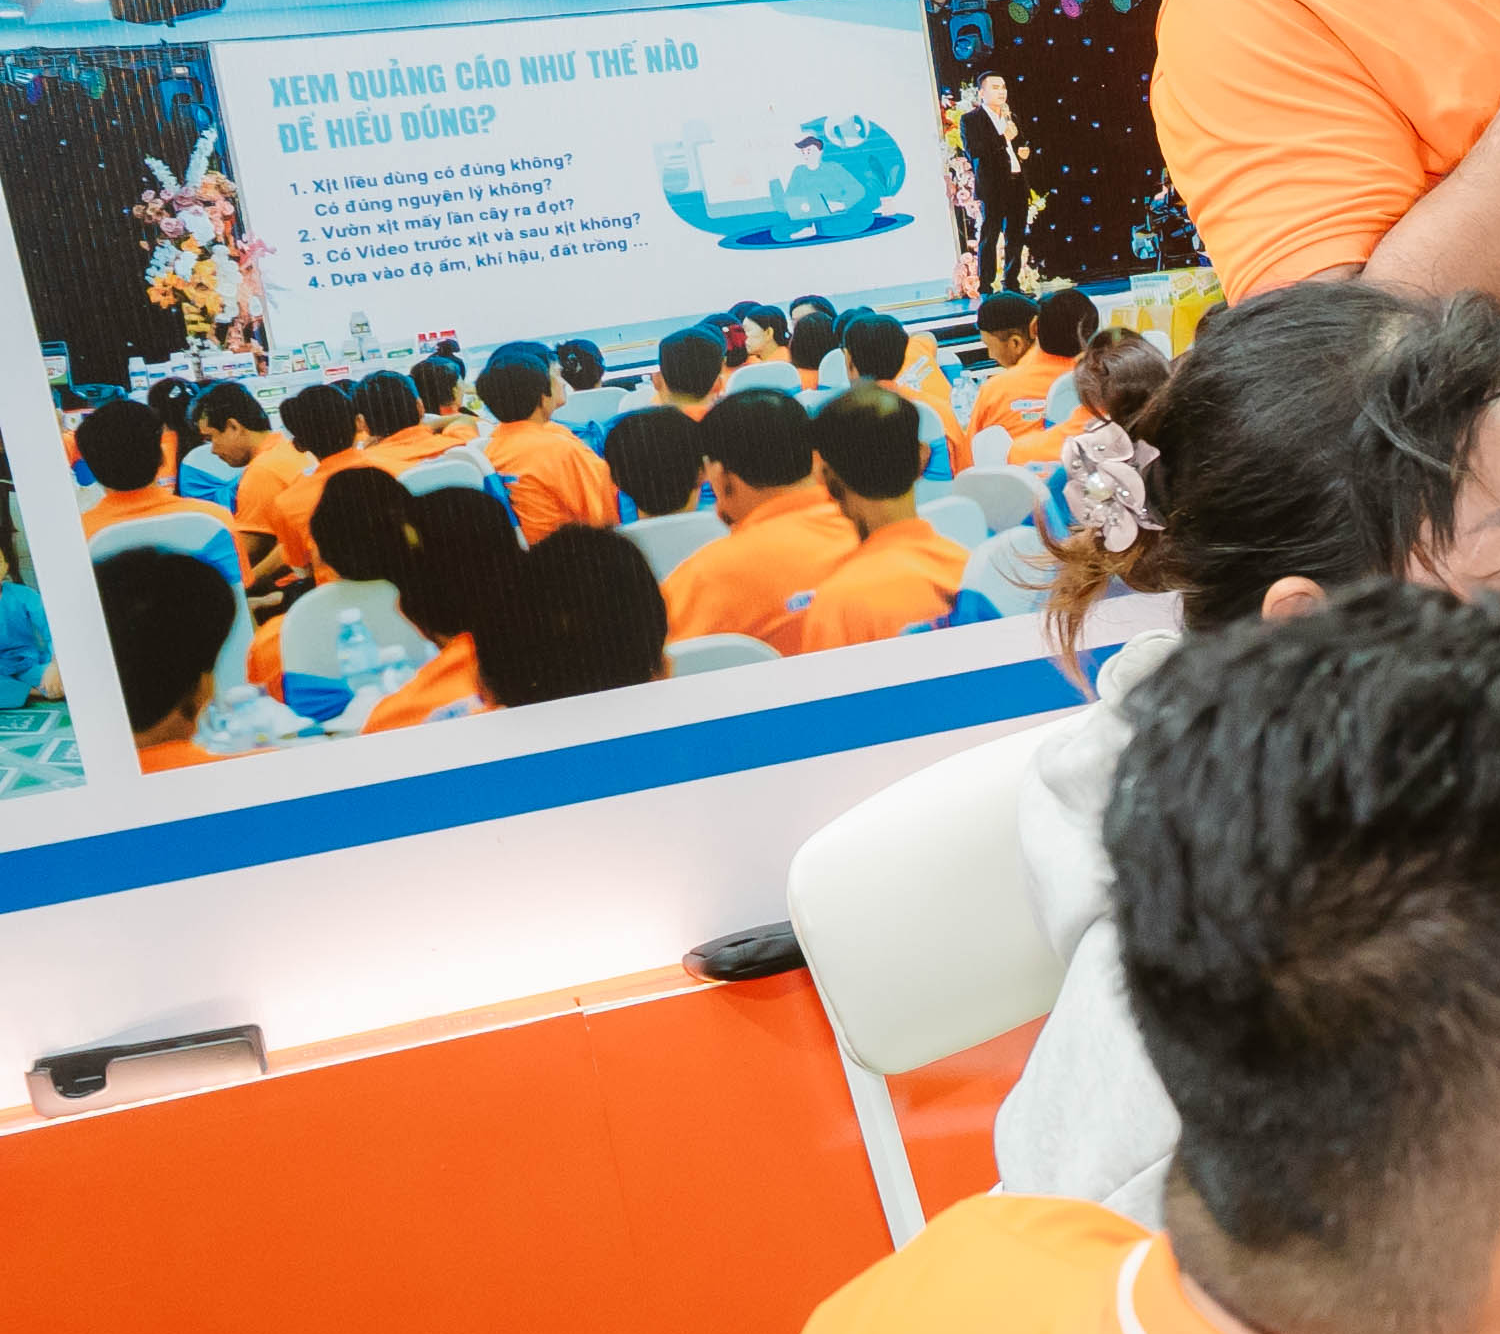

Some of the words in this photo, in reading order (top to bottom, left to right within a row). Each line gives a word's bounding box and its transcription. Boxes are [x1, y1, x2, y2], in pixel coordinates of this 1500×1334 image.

[269, 73, 338, 107] XEM
[347, 59, 446, 103] QUẢNG
[456, 54, 511, 91] CÁO
[520, 50, 576, 85] NHƯ
[586, 40, 638, 79] THẾ
[644, 38, 700, 73] NÀO
[327, 106, 392, 147] HIỂU
[401, 104, 496, 141] ĐÚNG?
[290, 183, 307, 196] 1.
[312, 179, 339, 195] Xịt
[434, 166, 455, 181] có
[511, 153, 573, 172] không?
[303, 251, 321, 266] 3.
[327, 247, 351, 263] Có
[357, 243, 409, 259] Video
[494, 228, 514, 241] và
[520, 225, 549, 238] sau
[580, 213, 641, 232] không?
